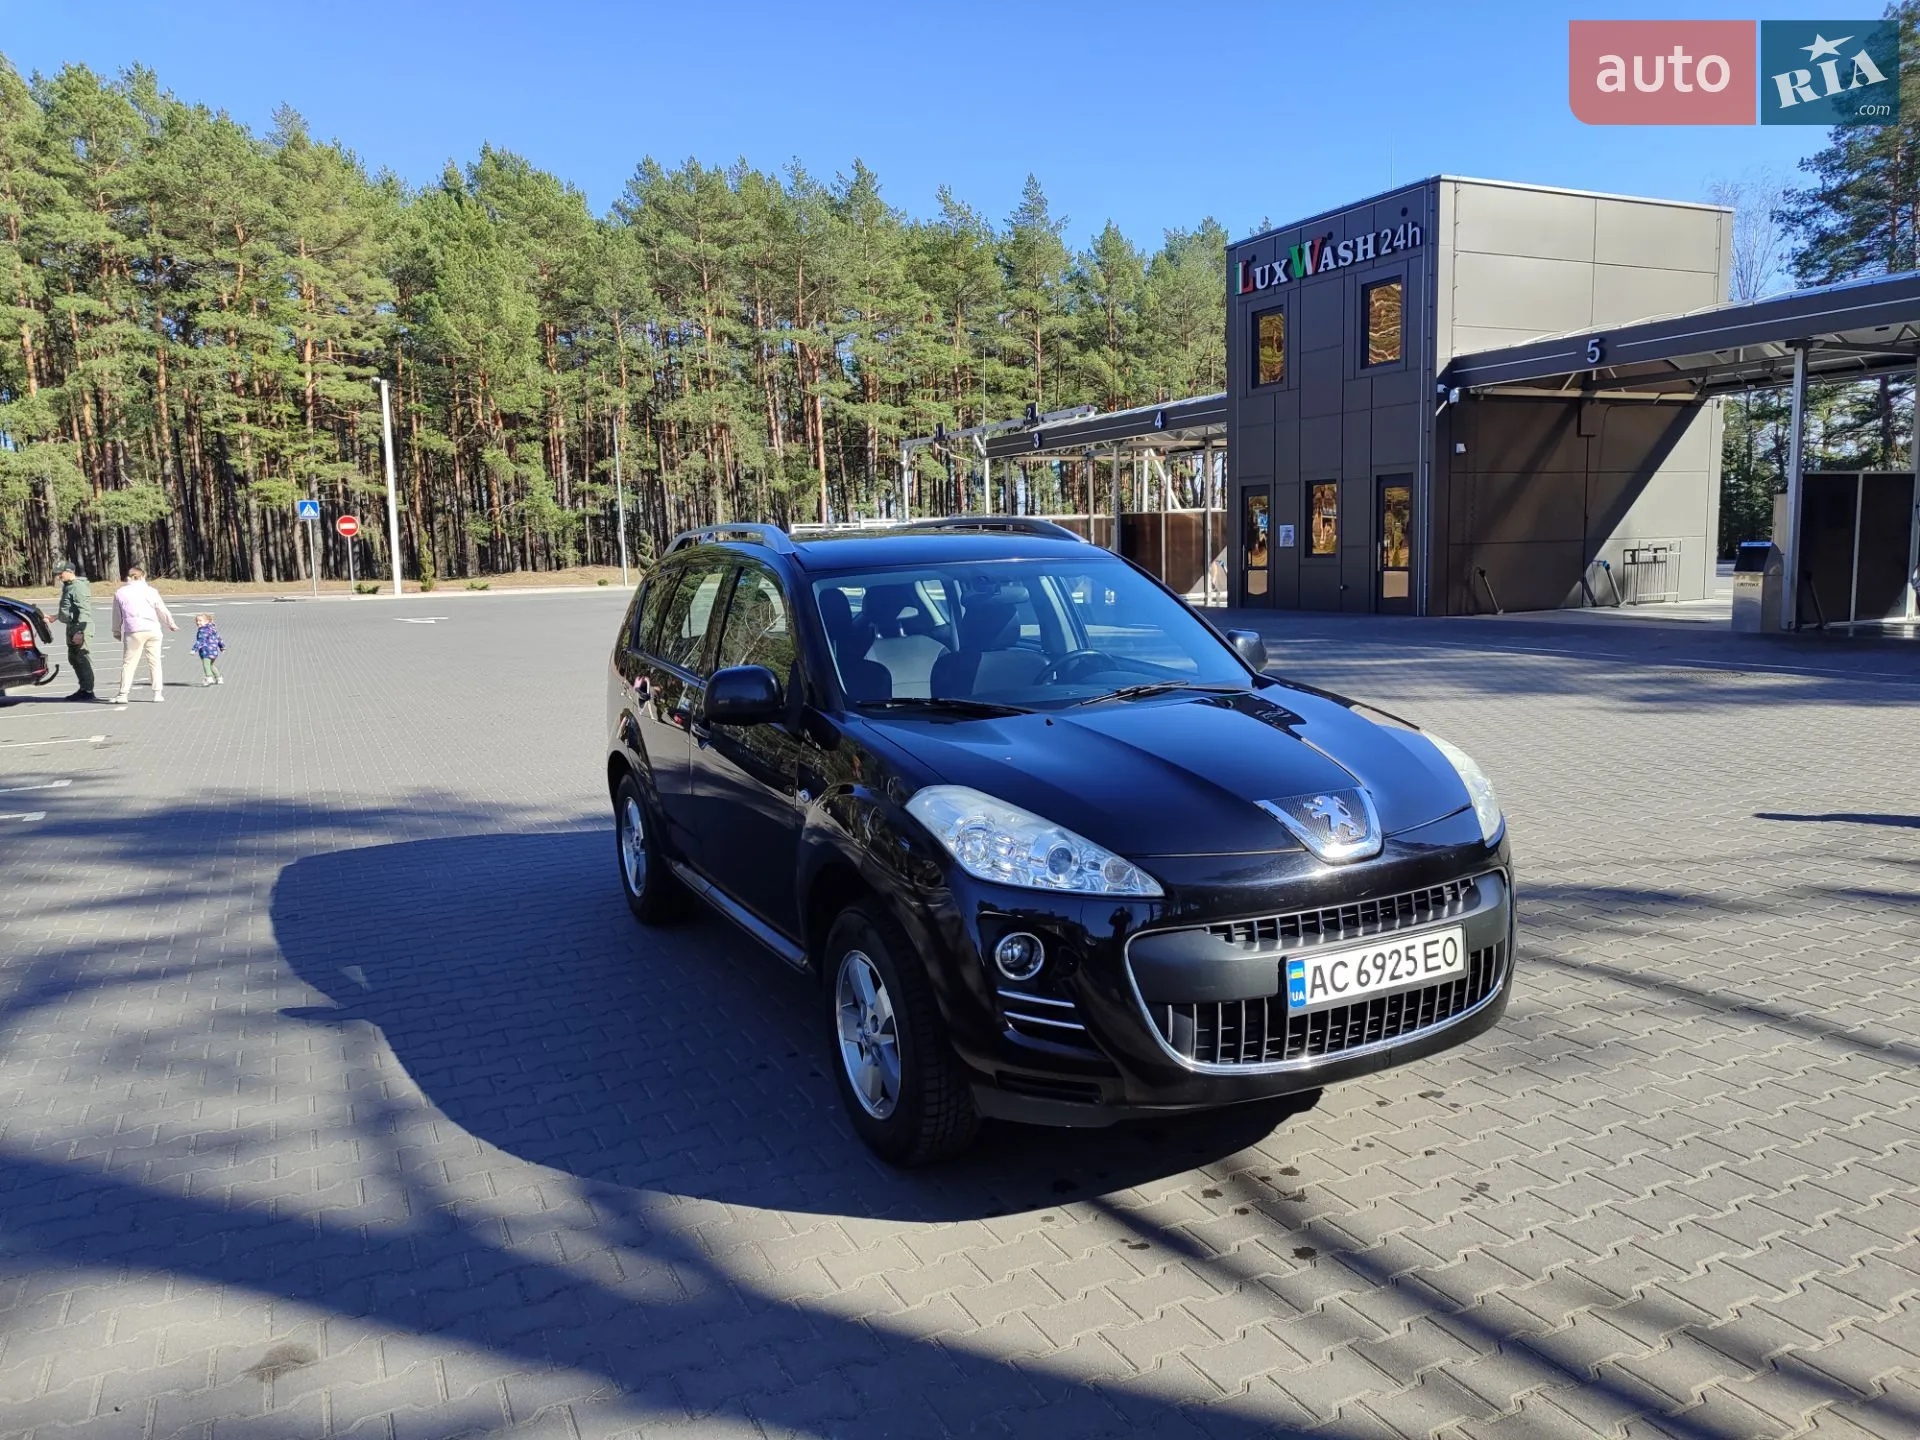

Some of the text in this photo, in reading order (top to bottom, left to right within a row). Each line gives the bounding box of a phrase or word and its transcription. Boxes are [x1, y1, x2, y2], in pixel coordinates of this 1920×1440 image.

[1586, 338, 1601, 364] 5
[1154, 410, 1163, 429] 4
[1033, 432, 1041, 449] 3
[1291, 990, 1306, 1002] UA
